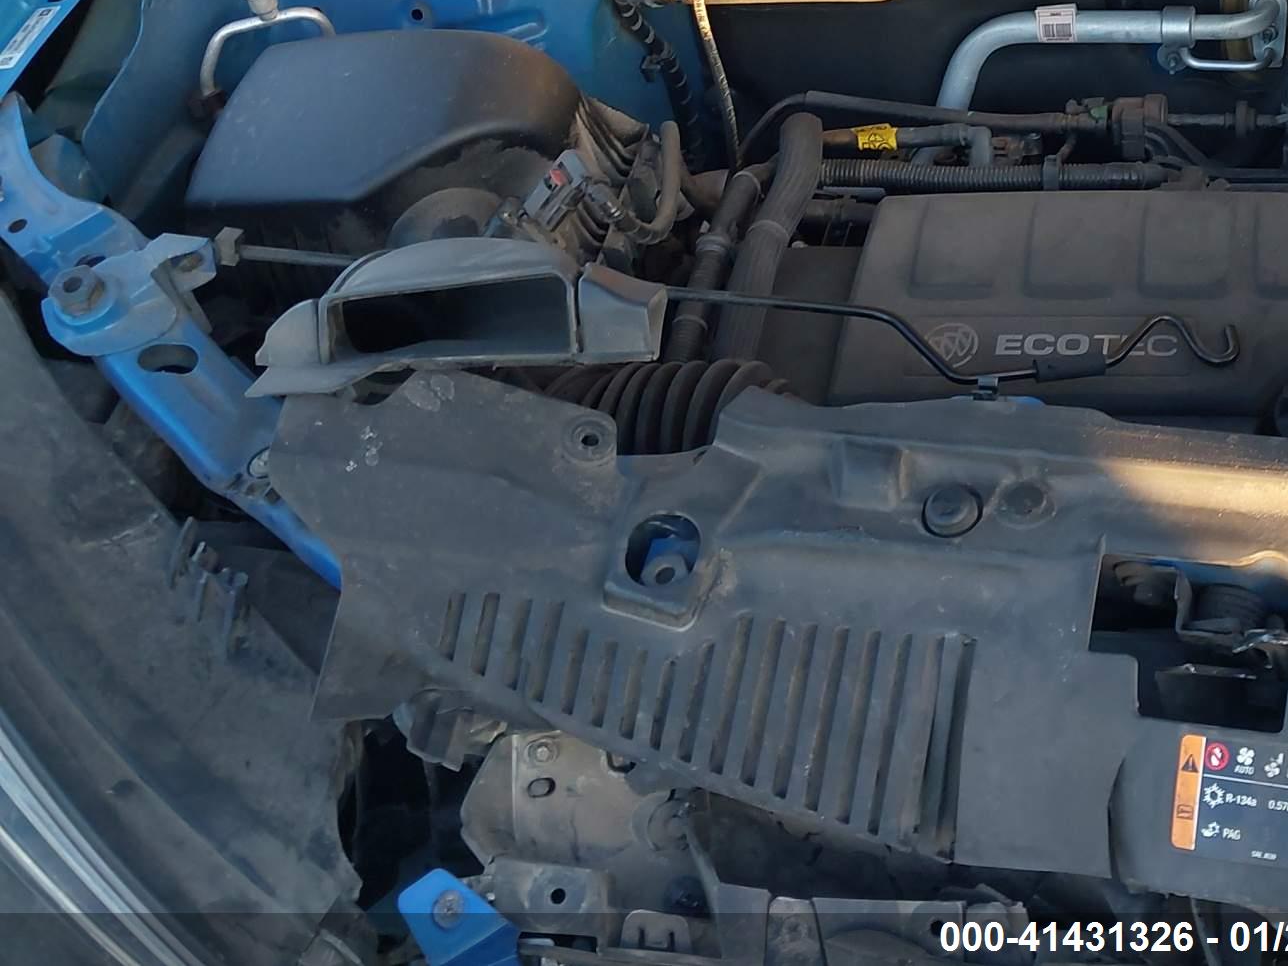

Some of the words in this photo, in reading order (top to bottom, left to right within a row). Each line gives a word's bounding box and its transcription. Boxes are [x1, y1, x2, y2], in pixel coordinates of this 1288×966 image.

[1234, 765, 1255, 776] AUTO
[1225, 793, 1258, 808] R-134a
[1222, 828, 1241, 841] PAG
